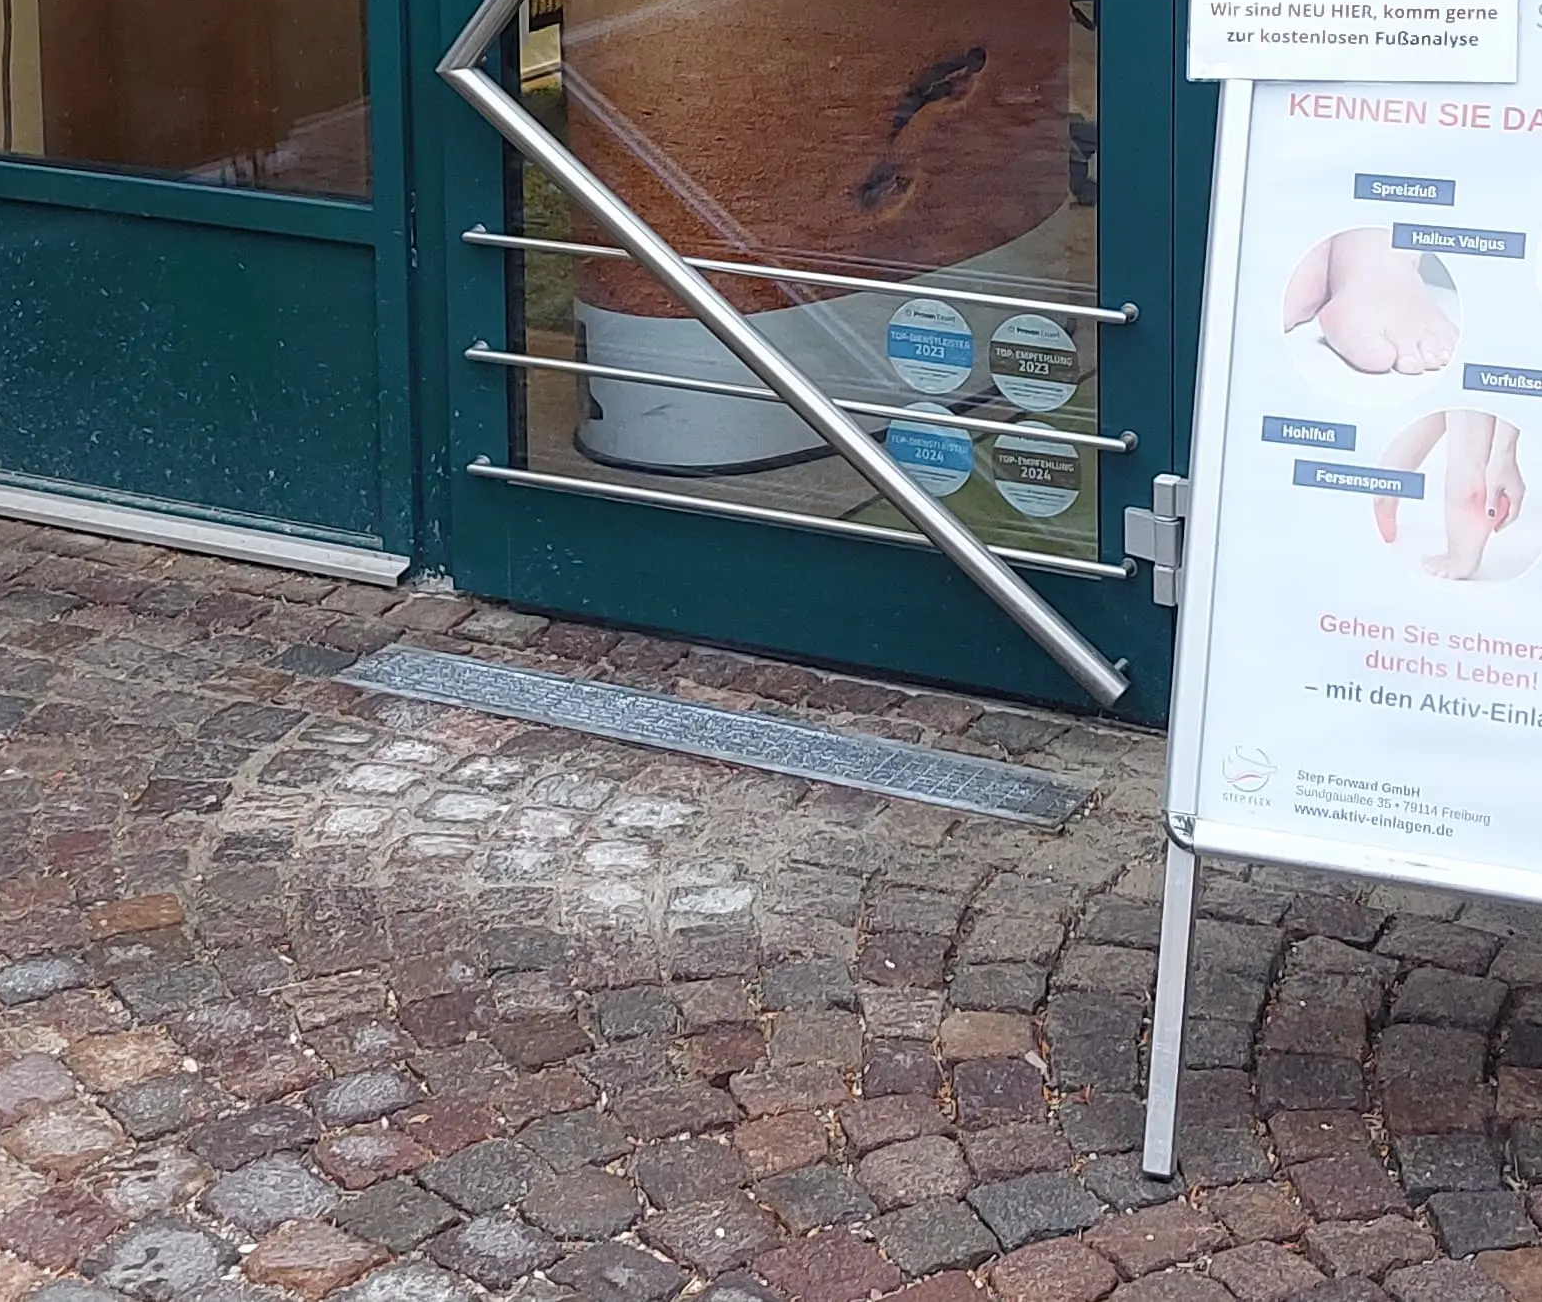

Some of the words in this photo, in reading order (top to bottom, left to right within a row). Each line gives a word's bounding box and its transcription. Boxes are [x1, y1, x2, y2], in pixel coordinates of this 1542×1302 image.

[1210, 1, 1241, 17] Wir
[1245, 1, 1282, 17] sind
[1288, 3, 1325, 18] NEU
[1331, 4, 1377, 21] HIER,
[1383, 4, 1440, 19] komm
[1445, 7, 1498, 24] gerne
[1226, 30, 1255, 43] zur
[1260, 27, 1369, 45] kostenlosen
[1375, 30, 1479, 48] Fußanalyse
[1288, 92, 1428, 126] KENNEN
[1437, 101, 1492, 129] SIE
[1370, 181, 1437, 200] Spreizfuß
[1411, 231, 1456, 248] Hallux
[1458, 234, 1505, 252] Valgus
[914, 343, 946, 359] 2023
[1018, 359, 1050, 376] 2023
[1282, 424, 1336, 443] Hohlfuß
[914, 447, 945, 464] 2024
[1020, 466, 1052, 482] 2024
[1315, 469, 1402, 492] Fersensporn
[1319, 613, 1395, 641] Gehen
[1403, 624, 1440, 647] Sie
[1365, 649, 1448, 678] durchs
[1456, 662, 1539, 691] Leben!
[1326, 681, 1363, 703] mit
[1369, 686, 1413, 710] den
[1297, 769, 1325, 785] Step
[1327, 774, 1379, 792] Forward
[1381, 782, 1421, 799] GmbH
[1295, 784, 1374, 807] Sundgauallee
[1376, 796, 1392, 809] 35
[1402, 799, 1439, 818] 79114
[1441, 806, 1491, 827] Freiburg
[1294, 802, 1455, 838] www.aktiv-einlagen.de
